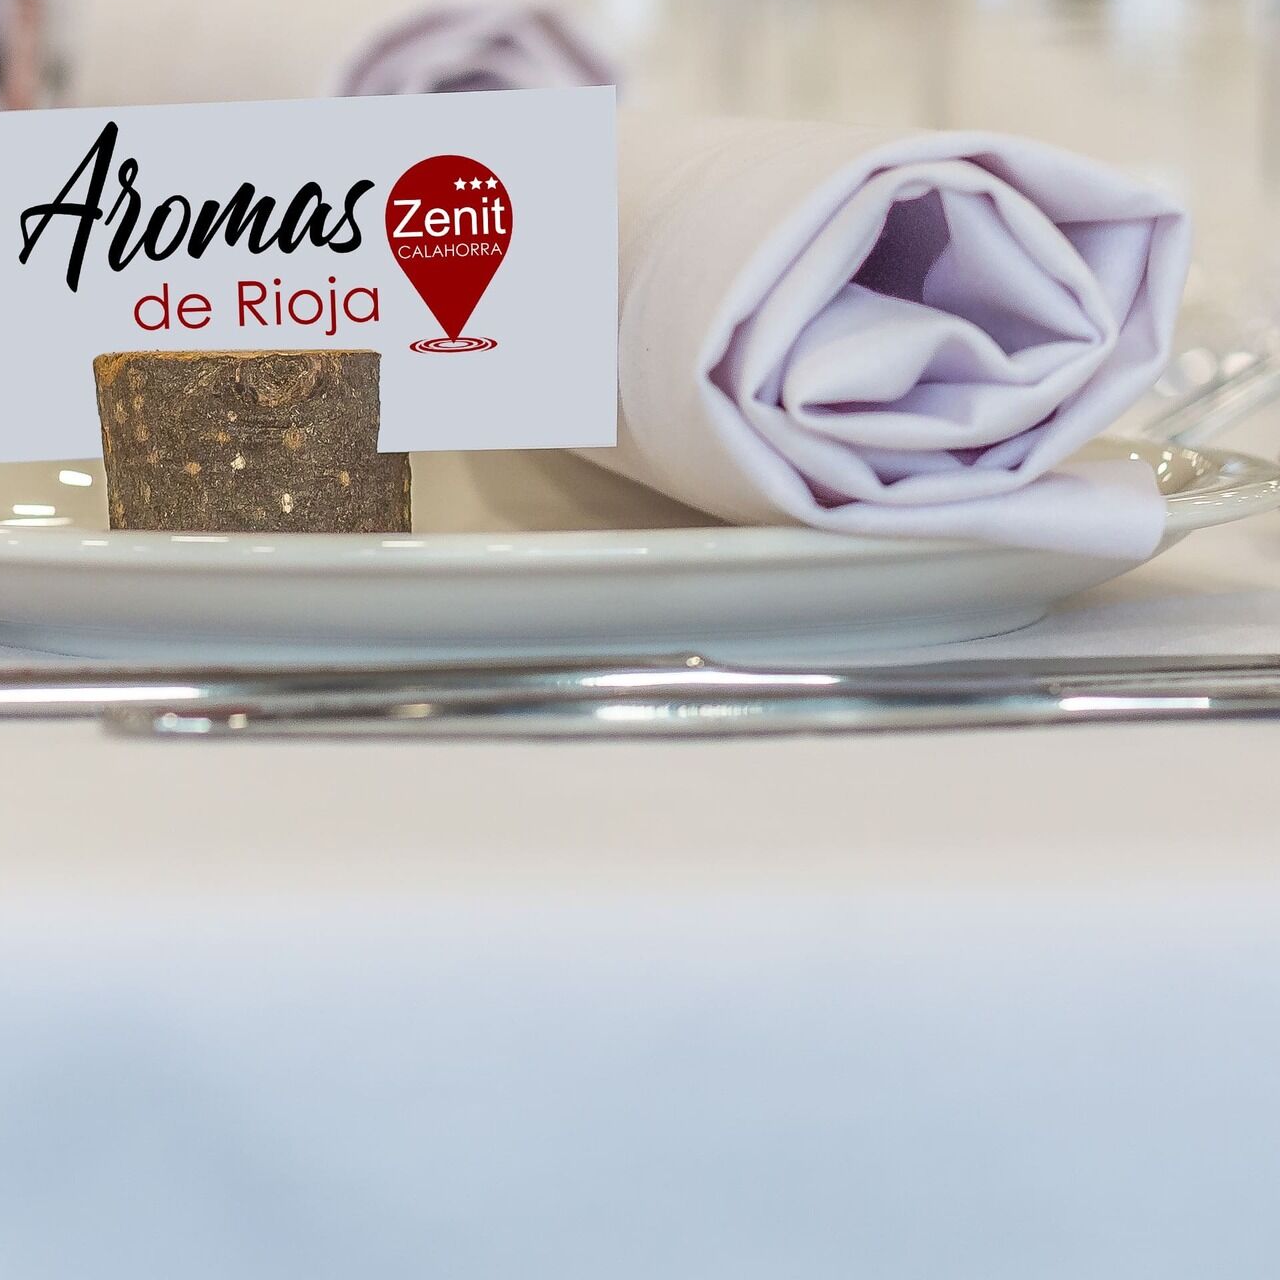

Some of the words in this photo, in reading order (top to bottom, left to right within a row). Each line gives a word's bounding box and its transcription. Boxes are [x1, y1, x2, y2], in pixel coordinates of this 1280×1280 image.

[19, 121, 376, 293] Aromas
[392, 196, 507, 238] Zenit
[397, 242, 503, 260] CALAHORRA
[133, 283, 212, 331] de
[237, 276, 380, 337] Rioja
